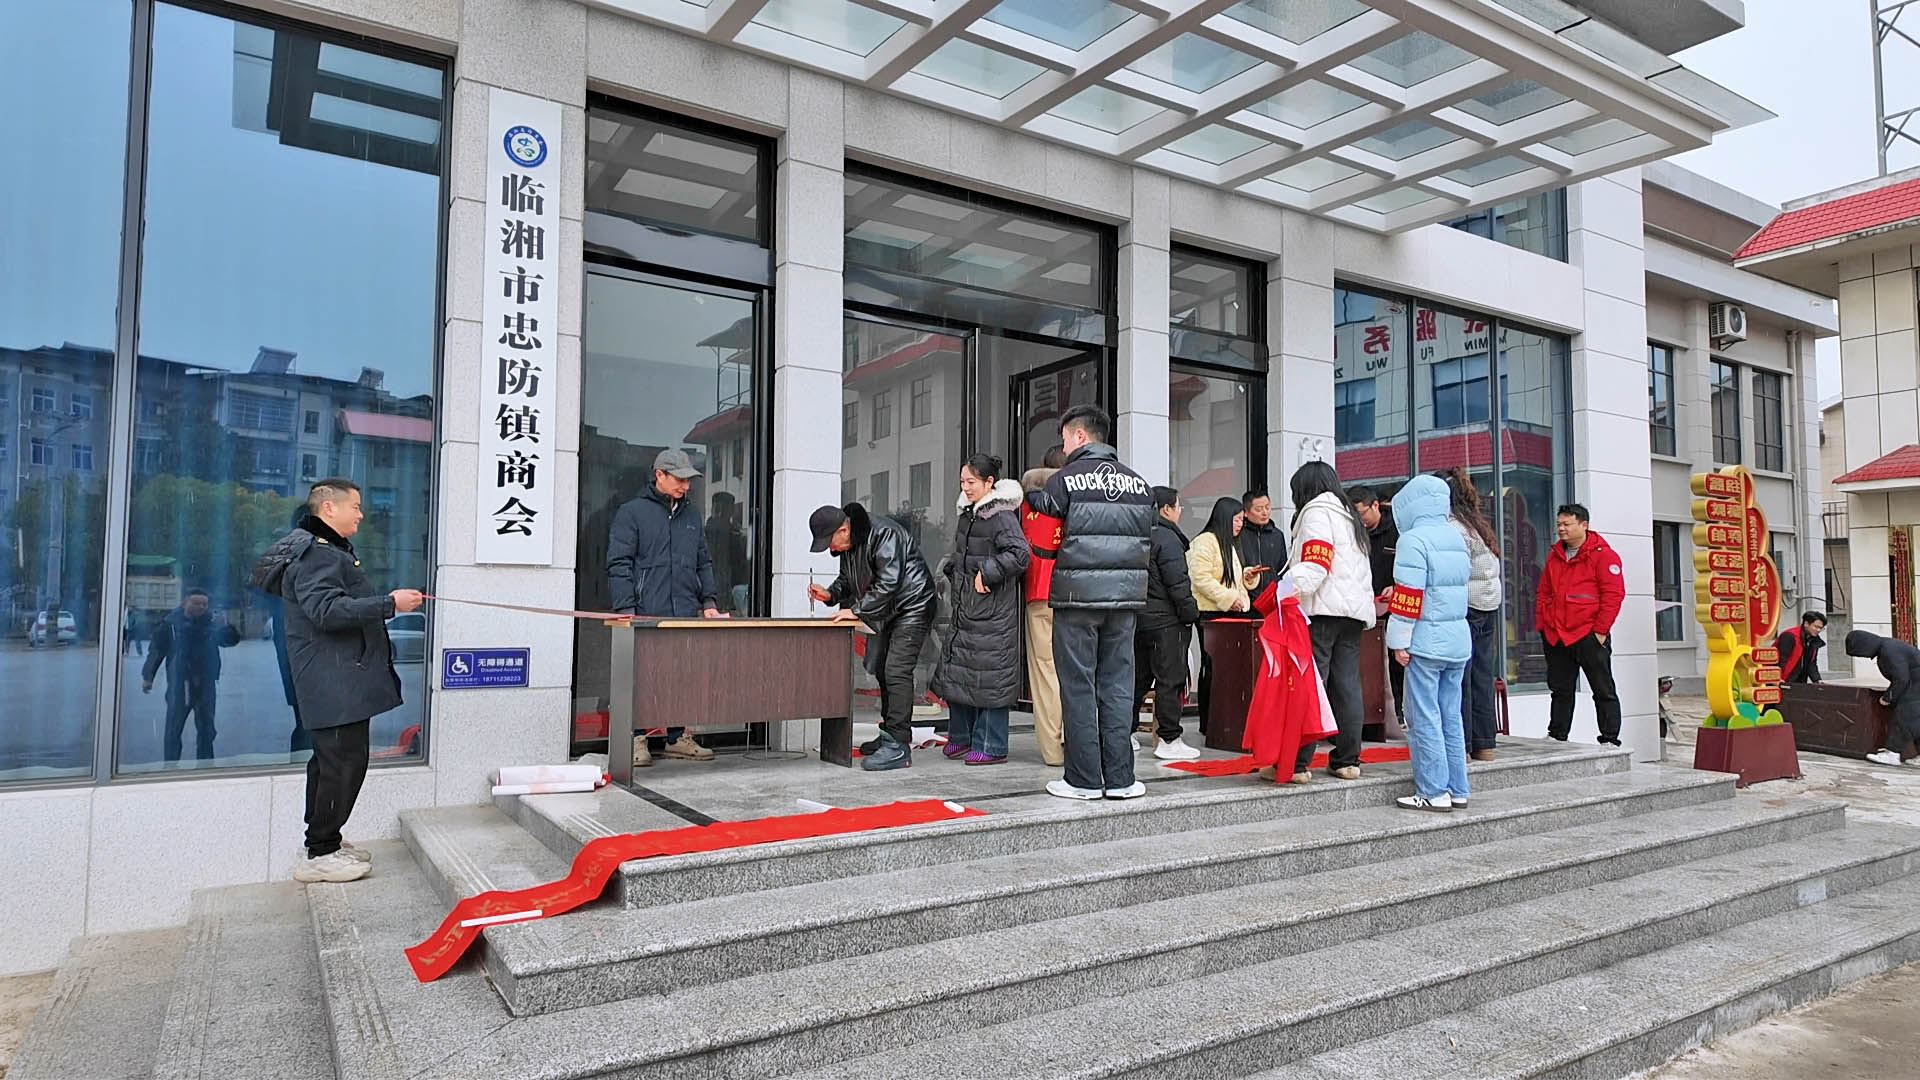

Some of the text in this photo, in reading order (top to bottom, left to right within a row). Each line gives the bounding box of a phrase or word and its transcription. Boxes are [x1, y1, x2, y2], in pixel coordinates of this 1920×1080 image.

[492, 174, 545, 536] 临湘市忠防镇商会
[1064, 472, 1105, 492] ROCK
